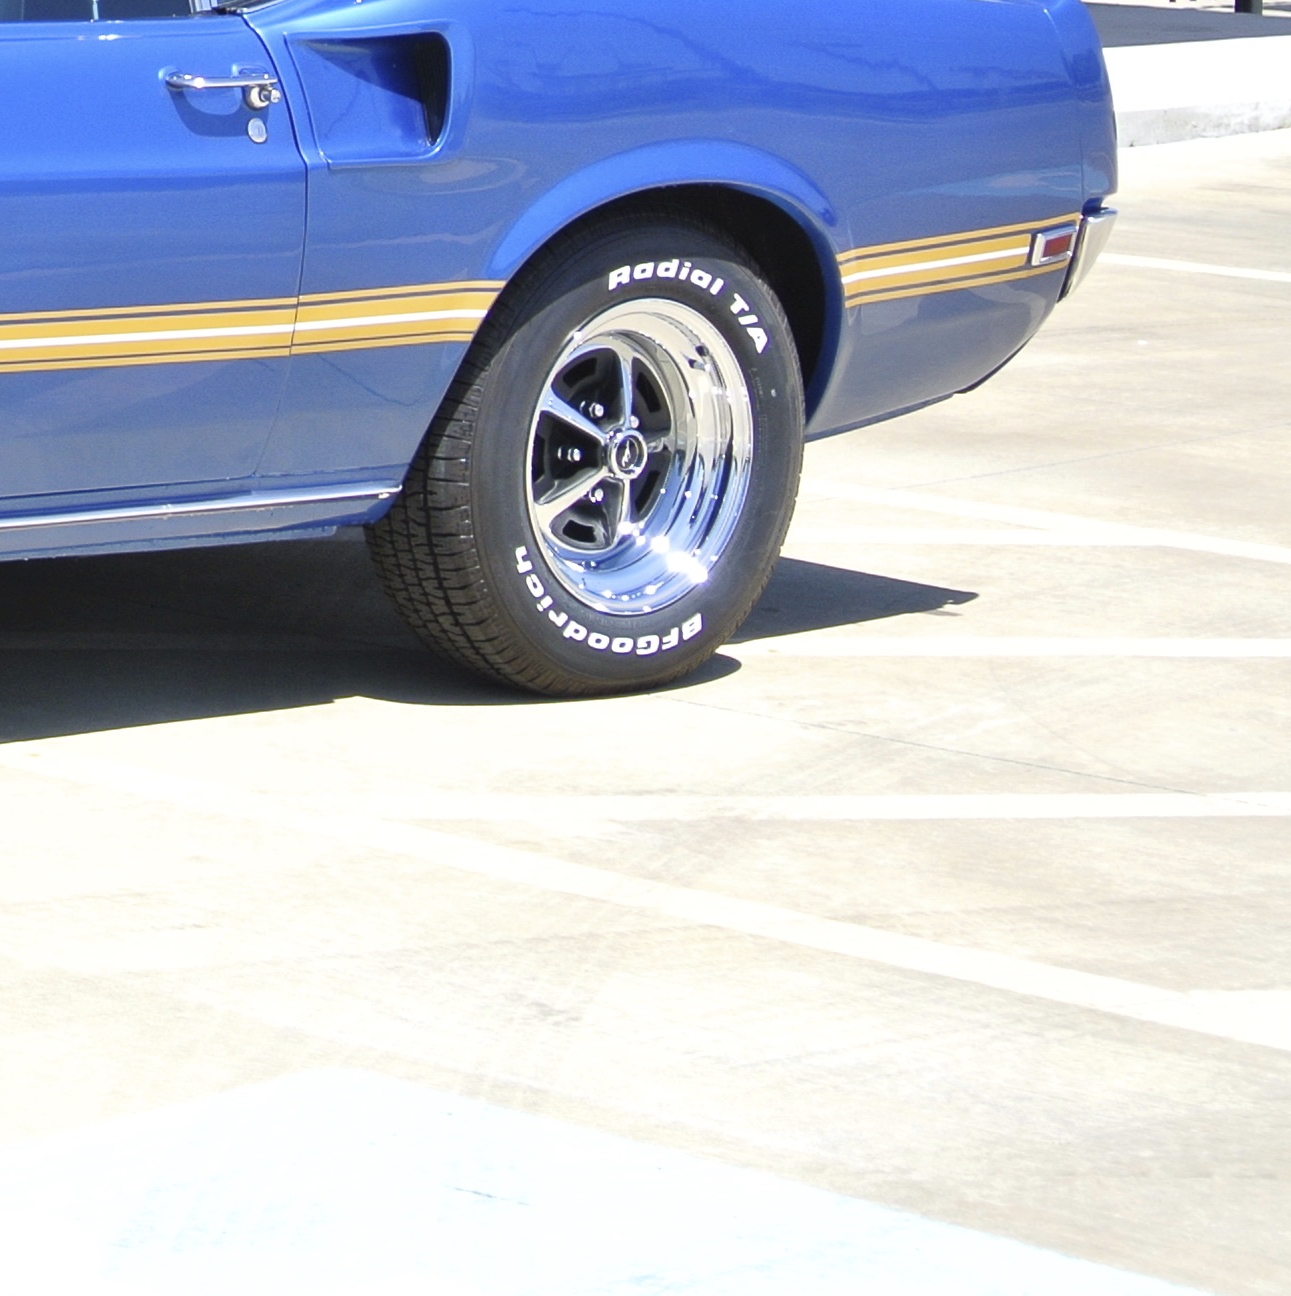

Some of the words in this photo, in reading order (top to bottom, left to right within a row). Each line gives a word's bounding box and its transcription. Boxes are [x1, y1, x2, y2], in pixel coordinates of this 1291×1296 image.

[608, 258, 725, 296] Radial
[730, 292, 769, 354] T/A
[514, 545, 703, 656] BFGoodrich
